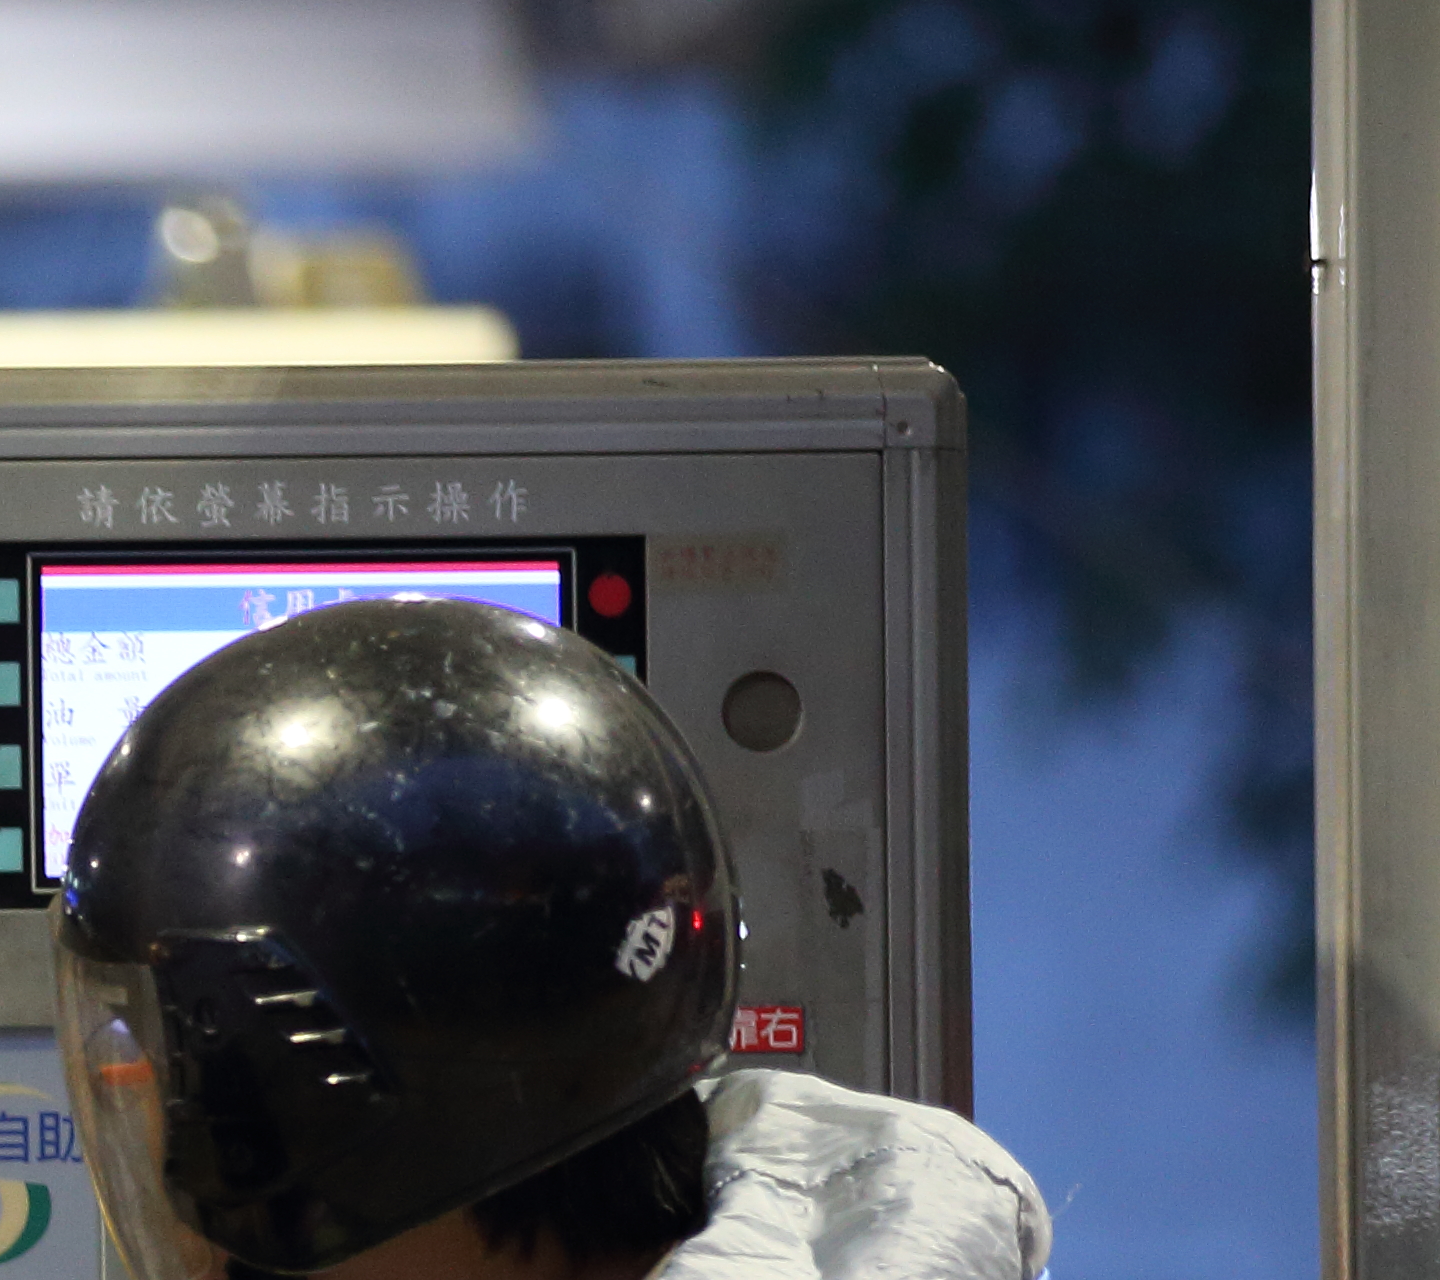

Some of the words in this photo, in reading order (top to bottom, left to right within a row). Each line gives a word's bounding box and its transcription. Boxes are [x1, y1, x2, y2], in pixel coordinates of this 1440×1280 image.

[77, 480, 529, 529] 請依螢幕指示操作
